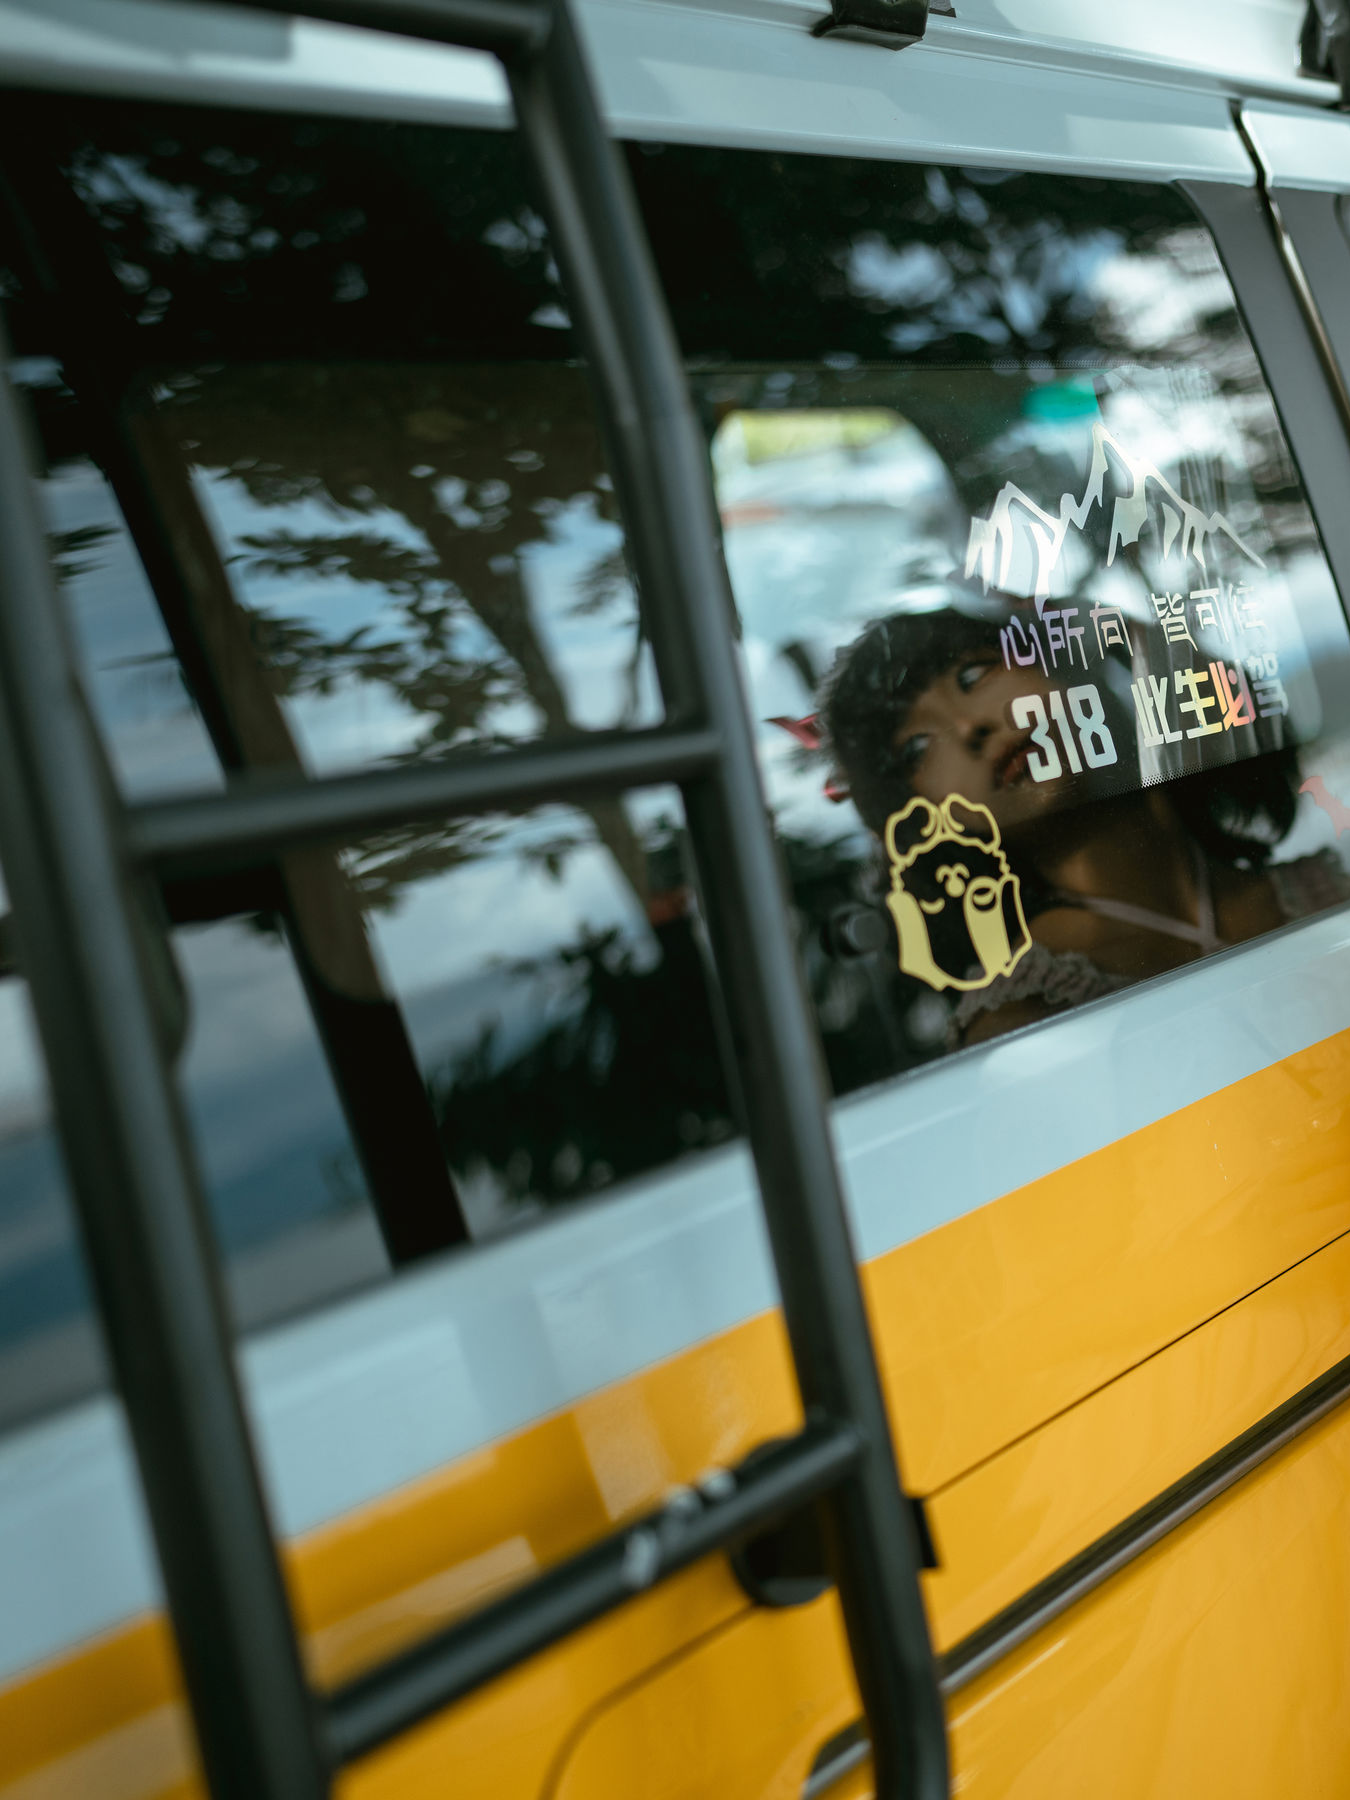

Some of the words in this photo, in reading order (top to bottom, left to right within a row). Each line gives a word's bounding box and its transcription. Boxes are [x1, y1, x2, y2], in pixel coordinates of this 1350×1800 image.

[1000, 601, 1133, 677] 心所向
[1151, 581, 1270, 652] 皆可往
[1011, 684, 1118, 783] 318
[1130, 652, 1289, 748] 此生必驾
